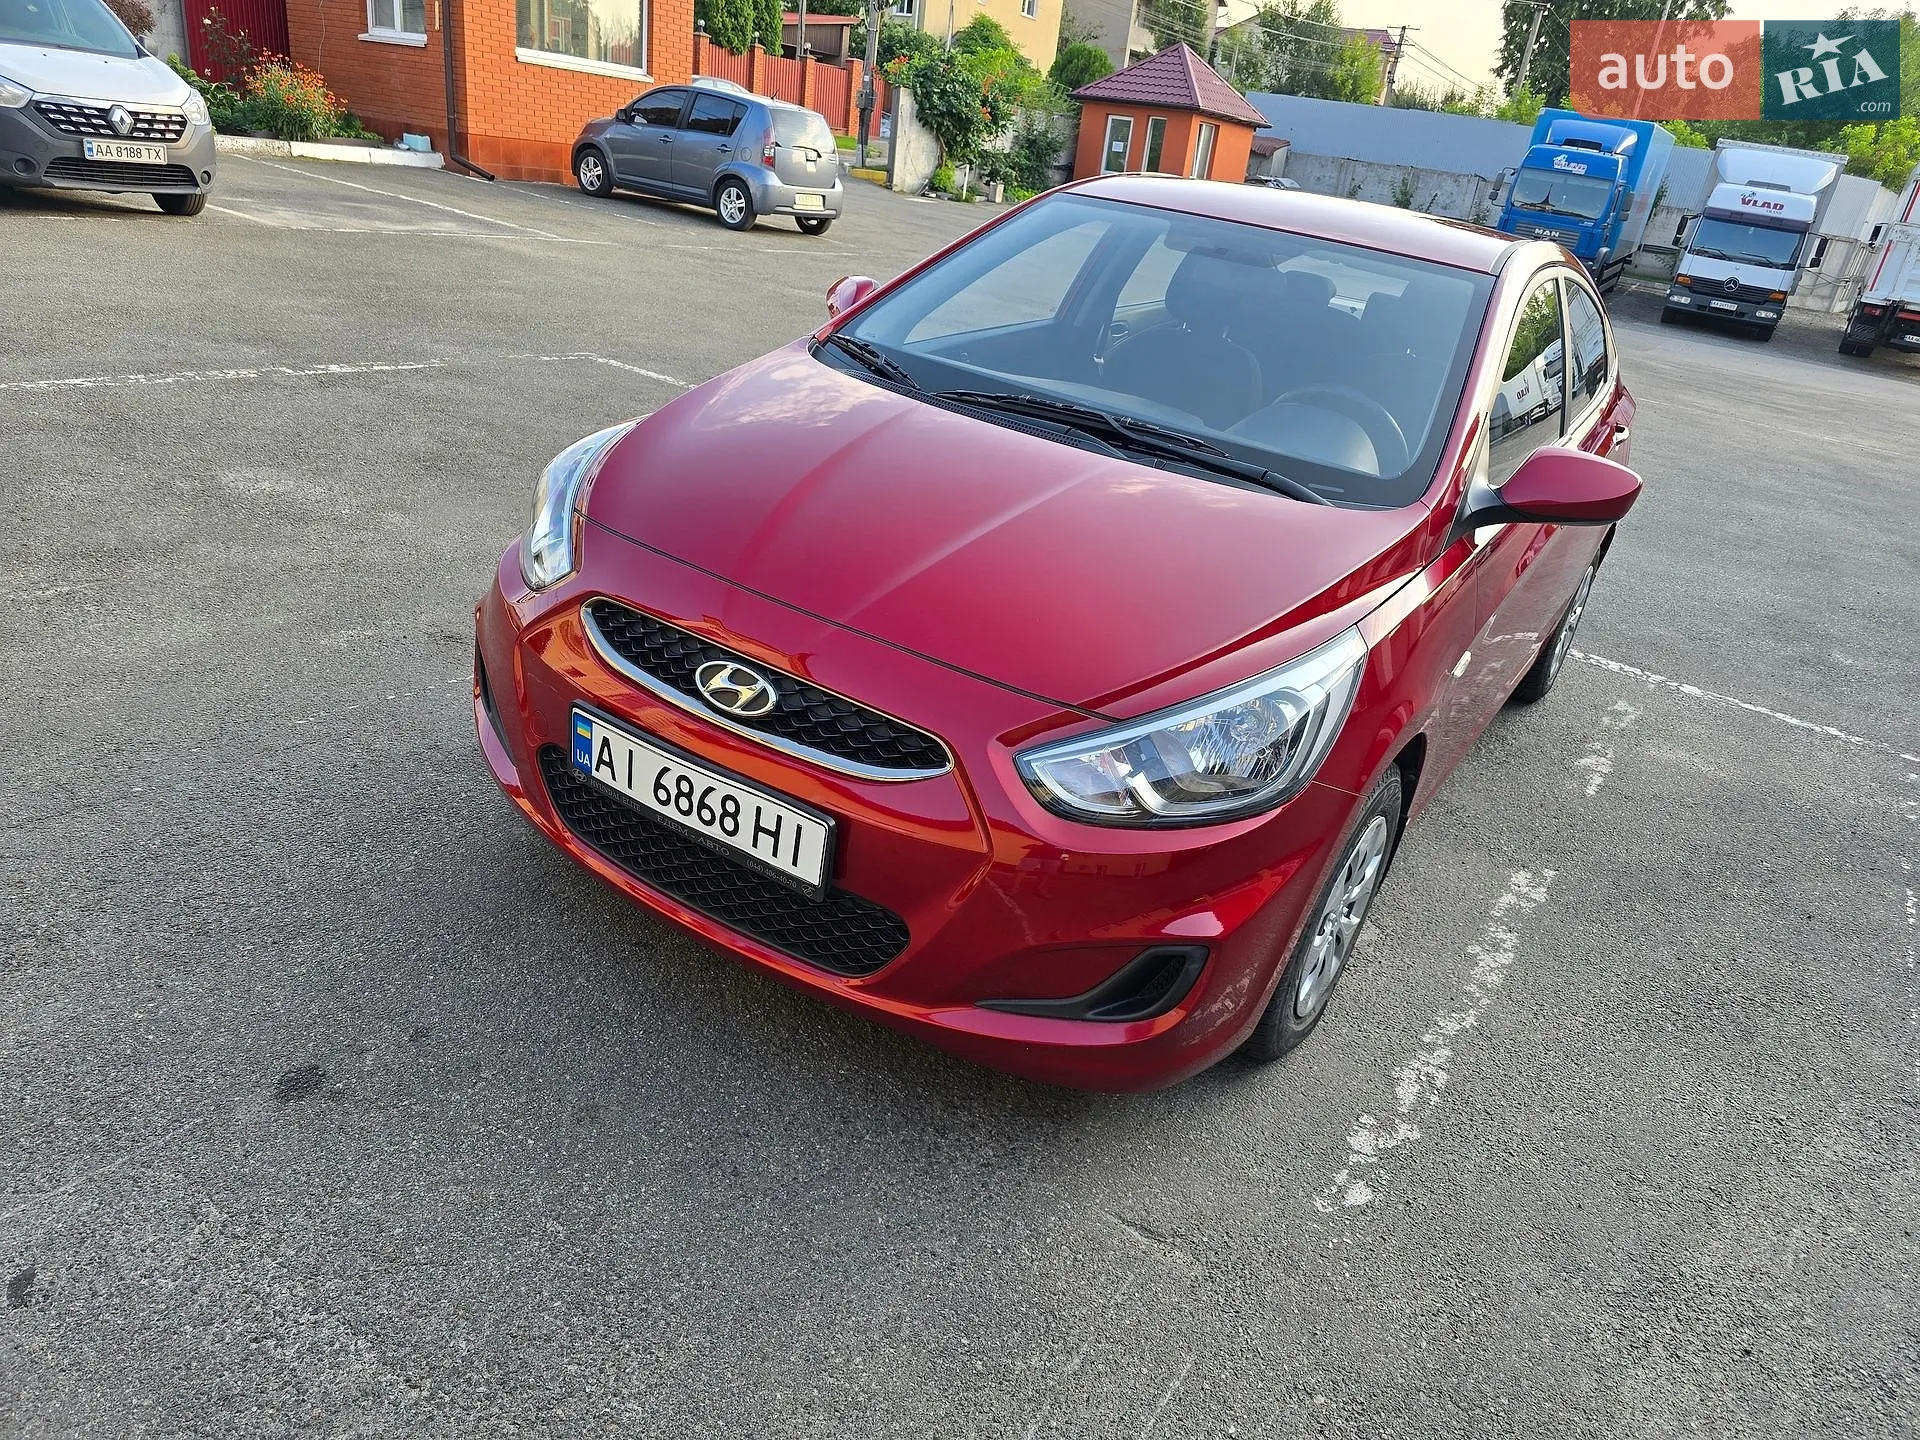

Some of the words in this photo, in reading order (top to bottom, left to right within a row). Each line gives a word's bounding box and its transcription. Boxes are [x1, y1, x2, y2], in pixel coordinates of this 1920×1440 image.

[95, 144, 114, 157] AA
[116, 146, 143, 160] 8188
[145, 146, 162, 160] TX
[1741, 196, 1785, 211] VLAD
[1534, 228, 1560, 238] MAN
[576, 749, 591, 768] UA
[590, 778, 620, 801] HYUNDAI
[594, 735, 634, 791] AI
[653, 765, 741, 838] 6868
[751, 805, 803, 868] HI
